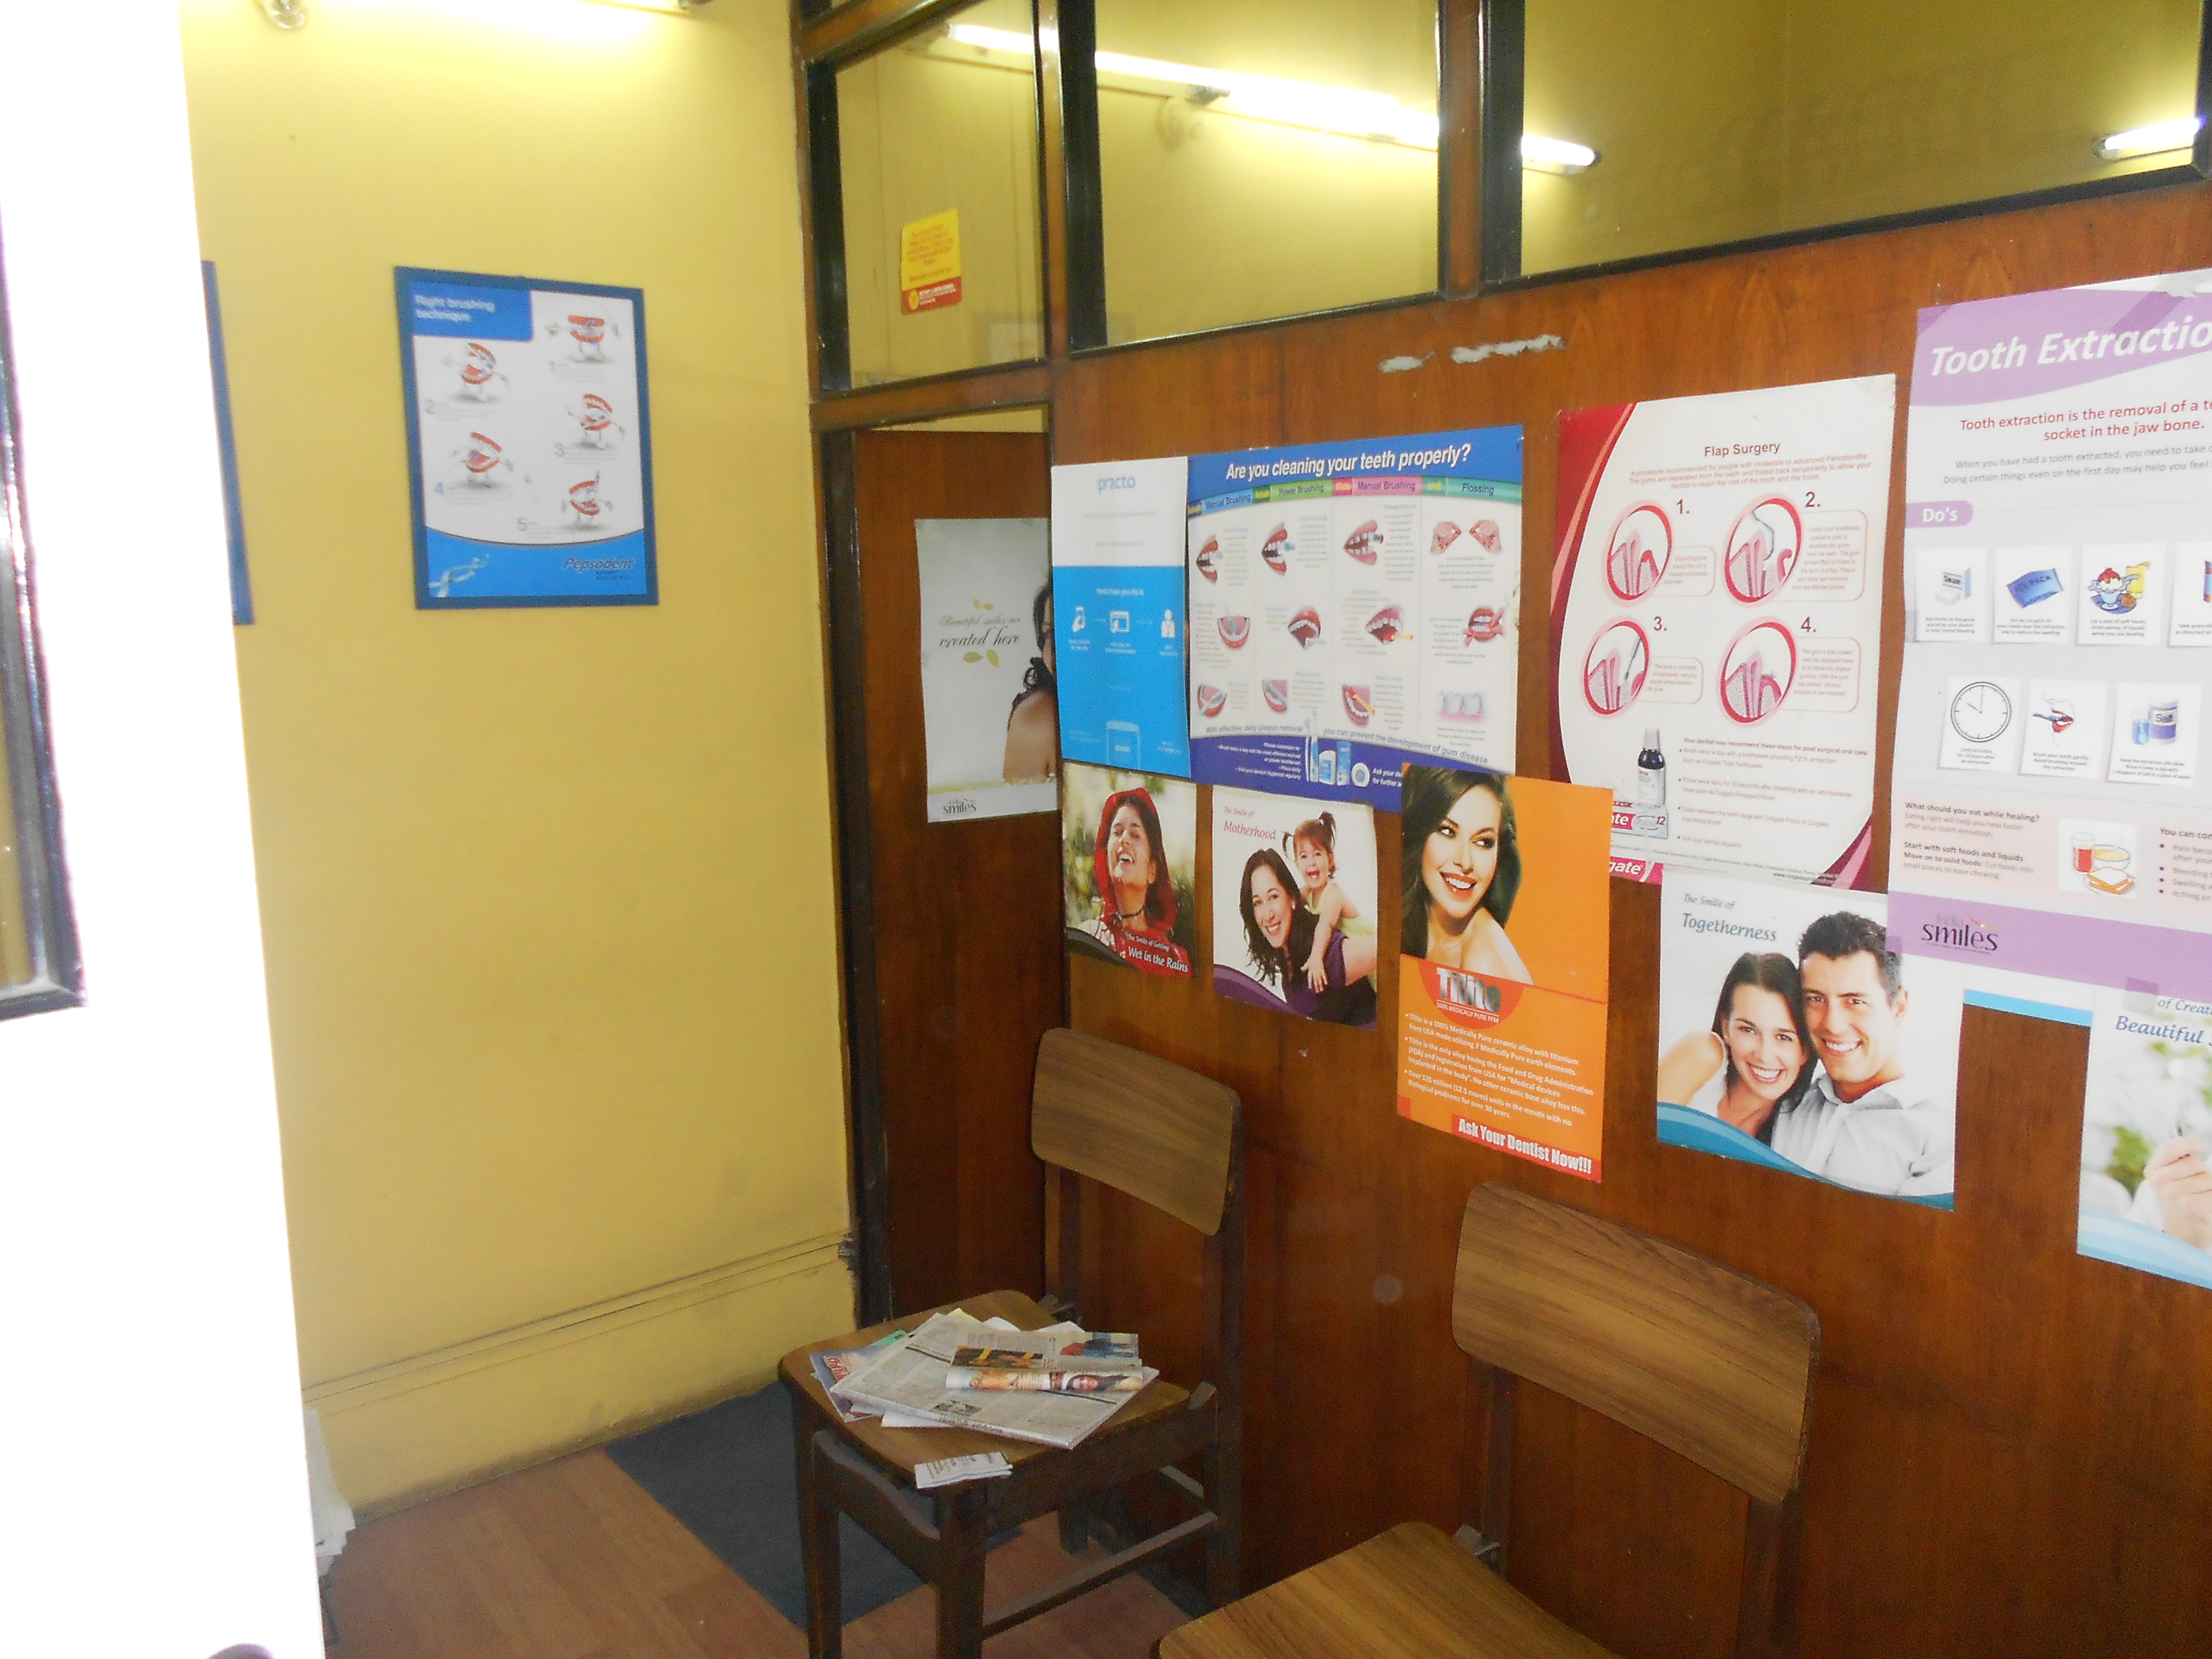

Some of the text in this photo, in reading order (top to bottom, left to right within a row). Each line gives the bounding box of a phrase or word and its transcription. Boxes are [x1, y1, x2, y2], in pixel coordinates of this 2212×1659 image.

[1931, 315, 2212, 377] Tooth Extractio
[1961, 400, 2198, 430] Tooth extraction is the removal of a
[2044, 420, 2204, 440] socket in the jaw bone.
[1705, 443, 1780, 458] Flap Surgery
[1982, 459, 1997, 469] you
[2000, 458, 2020, 466] have
[2049, 454, 2073, 463] tooth
[2076, 451, 2121, 460] extracted,
[2125, 451, 2141, 459] you
[2144, 447, 2168, 456] need
[2185, 445, 2205, 454] take
[1226, 443, 1472, 482] Are you cleaning your teeth properly?
[1098, 477, 1135, 495] practo
[1279, 487, 1296, 495] Power
[1298, 484, 1325, 494] Brushing
[1357, 481, 1415, 492] Manual Brushing
[1462, 483, 1494, 496] Flossing
[1205, 496, 1225, 509] Manual
[1226, 493, 1252, 505] Brushing
[1676, 499, 1690, 514] 1.
[1805, 492, 1820, 507] 2.
[1923, 507, 1959, 523] Do's
[1653, 616, 1667, 631] 3.
[1801, 616, 1816, 632] 4.
[940, 626, 1020, 648] created here
[1258, 725, 1278, 733] plaque
[1350, 731, 1374, 741] prevent
[1376, 733, 1386, 742] the
[1387, 736, 1431, 751] development
[1442, 748, 1458, 758] gum
[1460, 751, 1488, 764] disease
[943, 802, 976, 814] smiles
[1234, 808, 1247, 817] Smile
[1927, 804, 1951, 813] should
[1983, 811, 2004, 819] while
[2006, 812, 2040, 823] healing?
[1656, 816, 1667, 825] 12
[1224, 820, 1277, 840] Motherhood
[2160, 827, 2176, 836] You
[1904, 841, 1921, 849] Start
[1942, 845, 1956, 854] soft
[1959, 847, 1979, 856] foods
[1998, 852, 2024, 861] liquids
[1609, 861, 1641, 875] gate
[1684, 894, 1736, 910] The Smile of
[1683, 912, 1777, 942] Togetherness
[1922, 924, 1998, 951] smiles
[1129, 947, 1188, 973] Wet in the Rains
[2158, 998, 2174, 1009] of
[1449, 1005, 1474, 1017] MEDICALLY
[1474, 1012, 1487, 1021] PURE
[2116, 1015, 2204, 1044] Beautiful
[1434, 1020, 1449, 1030] 100%
[1450, 1026, 1477, 1039] Medically
[1478, 1033, 1492, 1043] Pure
[1493, 1038, 1518, 1049] ceramic
[1518, 1045, 1533, 1055] alloy
[1535, 1049, 1549, 1058] with
[1550, 1053, 1579, 1065] titanium
[1429, 1043, 1438, 1051] the
[1439, 1047, 1451, 1056] only
[1452, 1050, 1465, 1060] alloy
[1466, 1055, 1486, 1067] having
[1498, 1064, 1514, 1073] Food
[1515, 1069, 1527, 1077] and
[1528, 1072, 1544, 1083] Drug
[1544, 1077, 1594, 1096] Administration
[1459, 1118, 1592, 1174] Ask Your Dentist Now!!!
